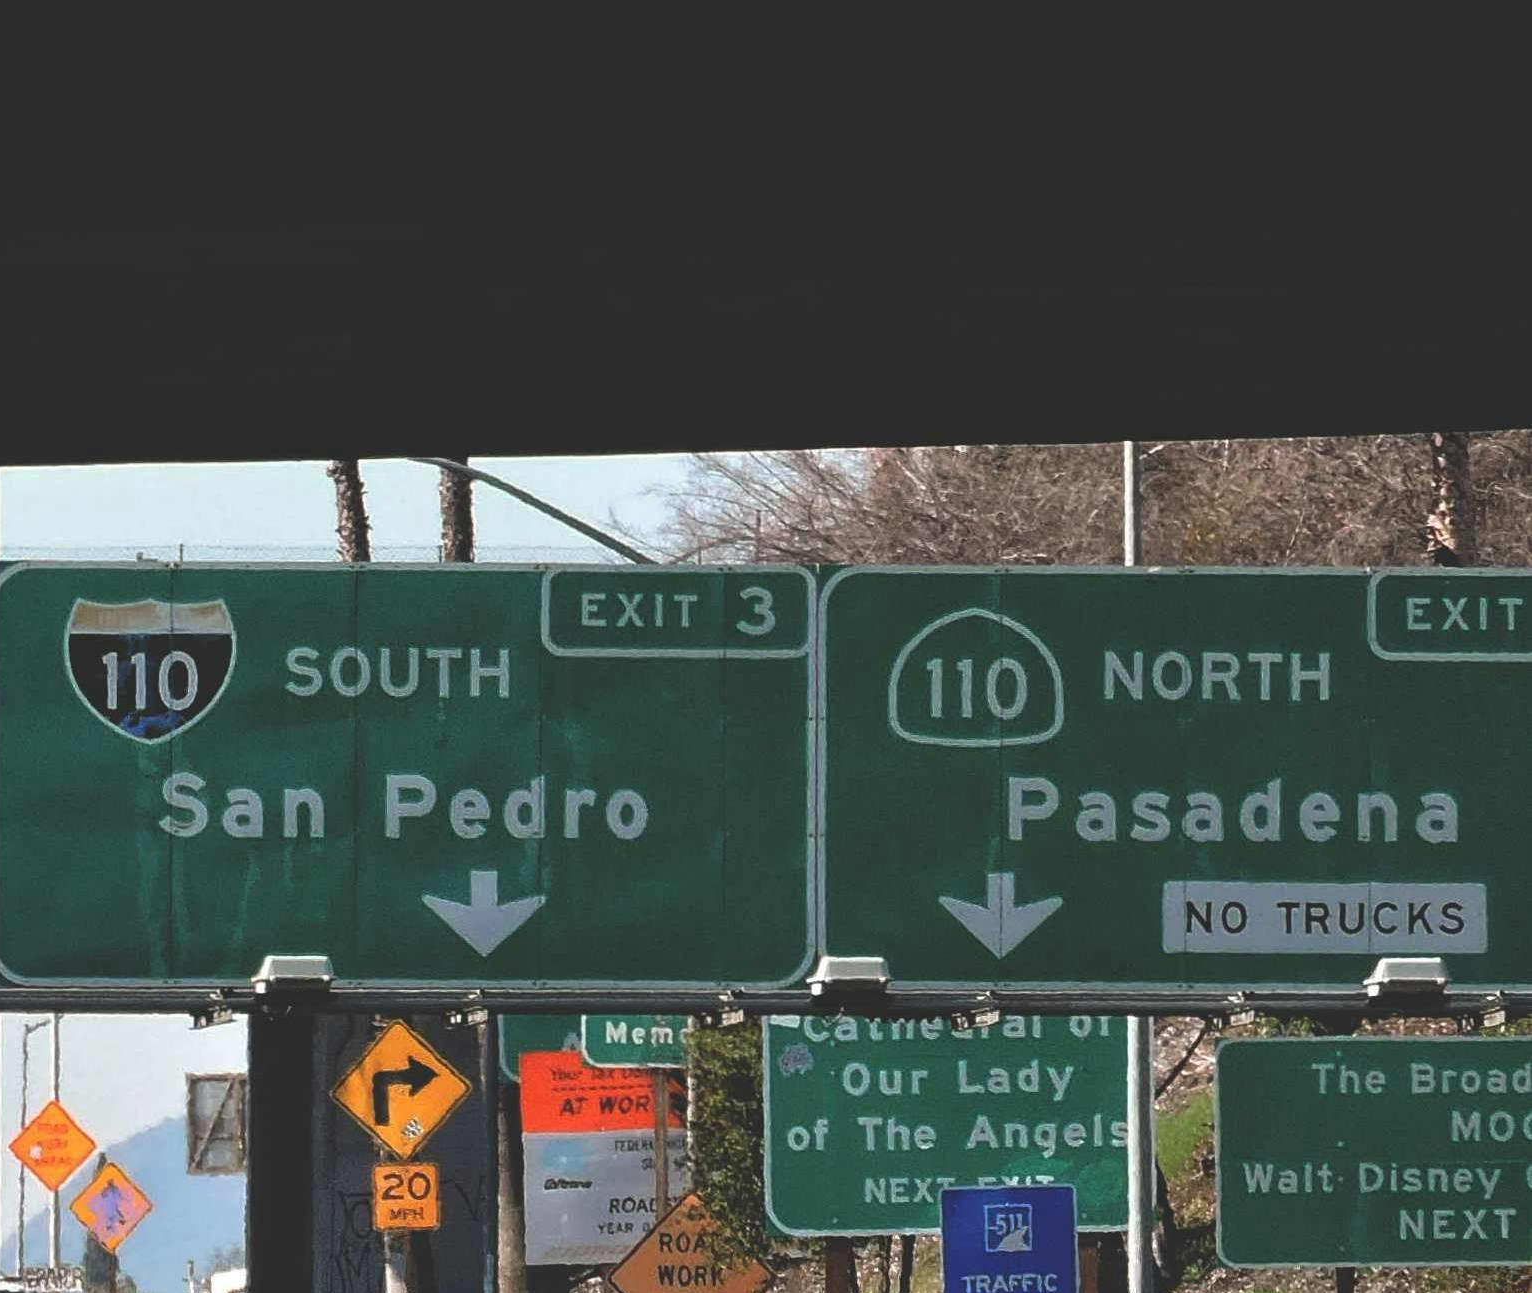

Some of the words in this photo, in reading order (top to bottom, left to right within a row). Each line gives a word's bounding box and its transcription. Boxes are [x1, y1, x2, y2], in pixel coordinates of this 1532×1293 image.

[580, 591, 698, 628] EXIT
[736, 586, 777, 636] 3
[1406, 597, 1523, 631] EXIT
[101, 650, 198, 711] 110
[285, 646, 512, 698] SOUTH
[925, 658, 1028, 721] 110
[1103, 650, 1331, 702] NORTH
[158, 771, 328, 840] San
[384, 772, 650, 841] Pedro
[1007, 775, 1460, 844] Pasadena
[1185, 899, 1249, 935] NO
[1277, 899, 1466, 935] TRUCKS
[842, 1062, 928, 1096] Our
[958, 1059, 1074, 1101] Lady
[1310, 1063, 1386, 1095] The
[1410, 1062, 1532, 1095] Broad
[559, 1096, 587, 1117] AT
[598, 1095, 652, 1115] WOR
[787, 1117, 829, 1151] of
[857, 1116, 937, 1151] The
[966, 1113, 1128, 1159] Angels
[382, 1172, 432, 1201] 20
[1243, 1162, 1334, 1194] Walt
[1359, 1162, 1501, 1200] Disney
[390, 1207, 425, 1221] MPH
[994, 1212, 1023, 1235] 511
[1399, 1208, 1517, 1240] NEXT
[657, 1265, 726, 1288] WORK
[960, 1273, 1058, 1293] TRAFFIC
